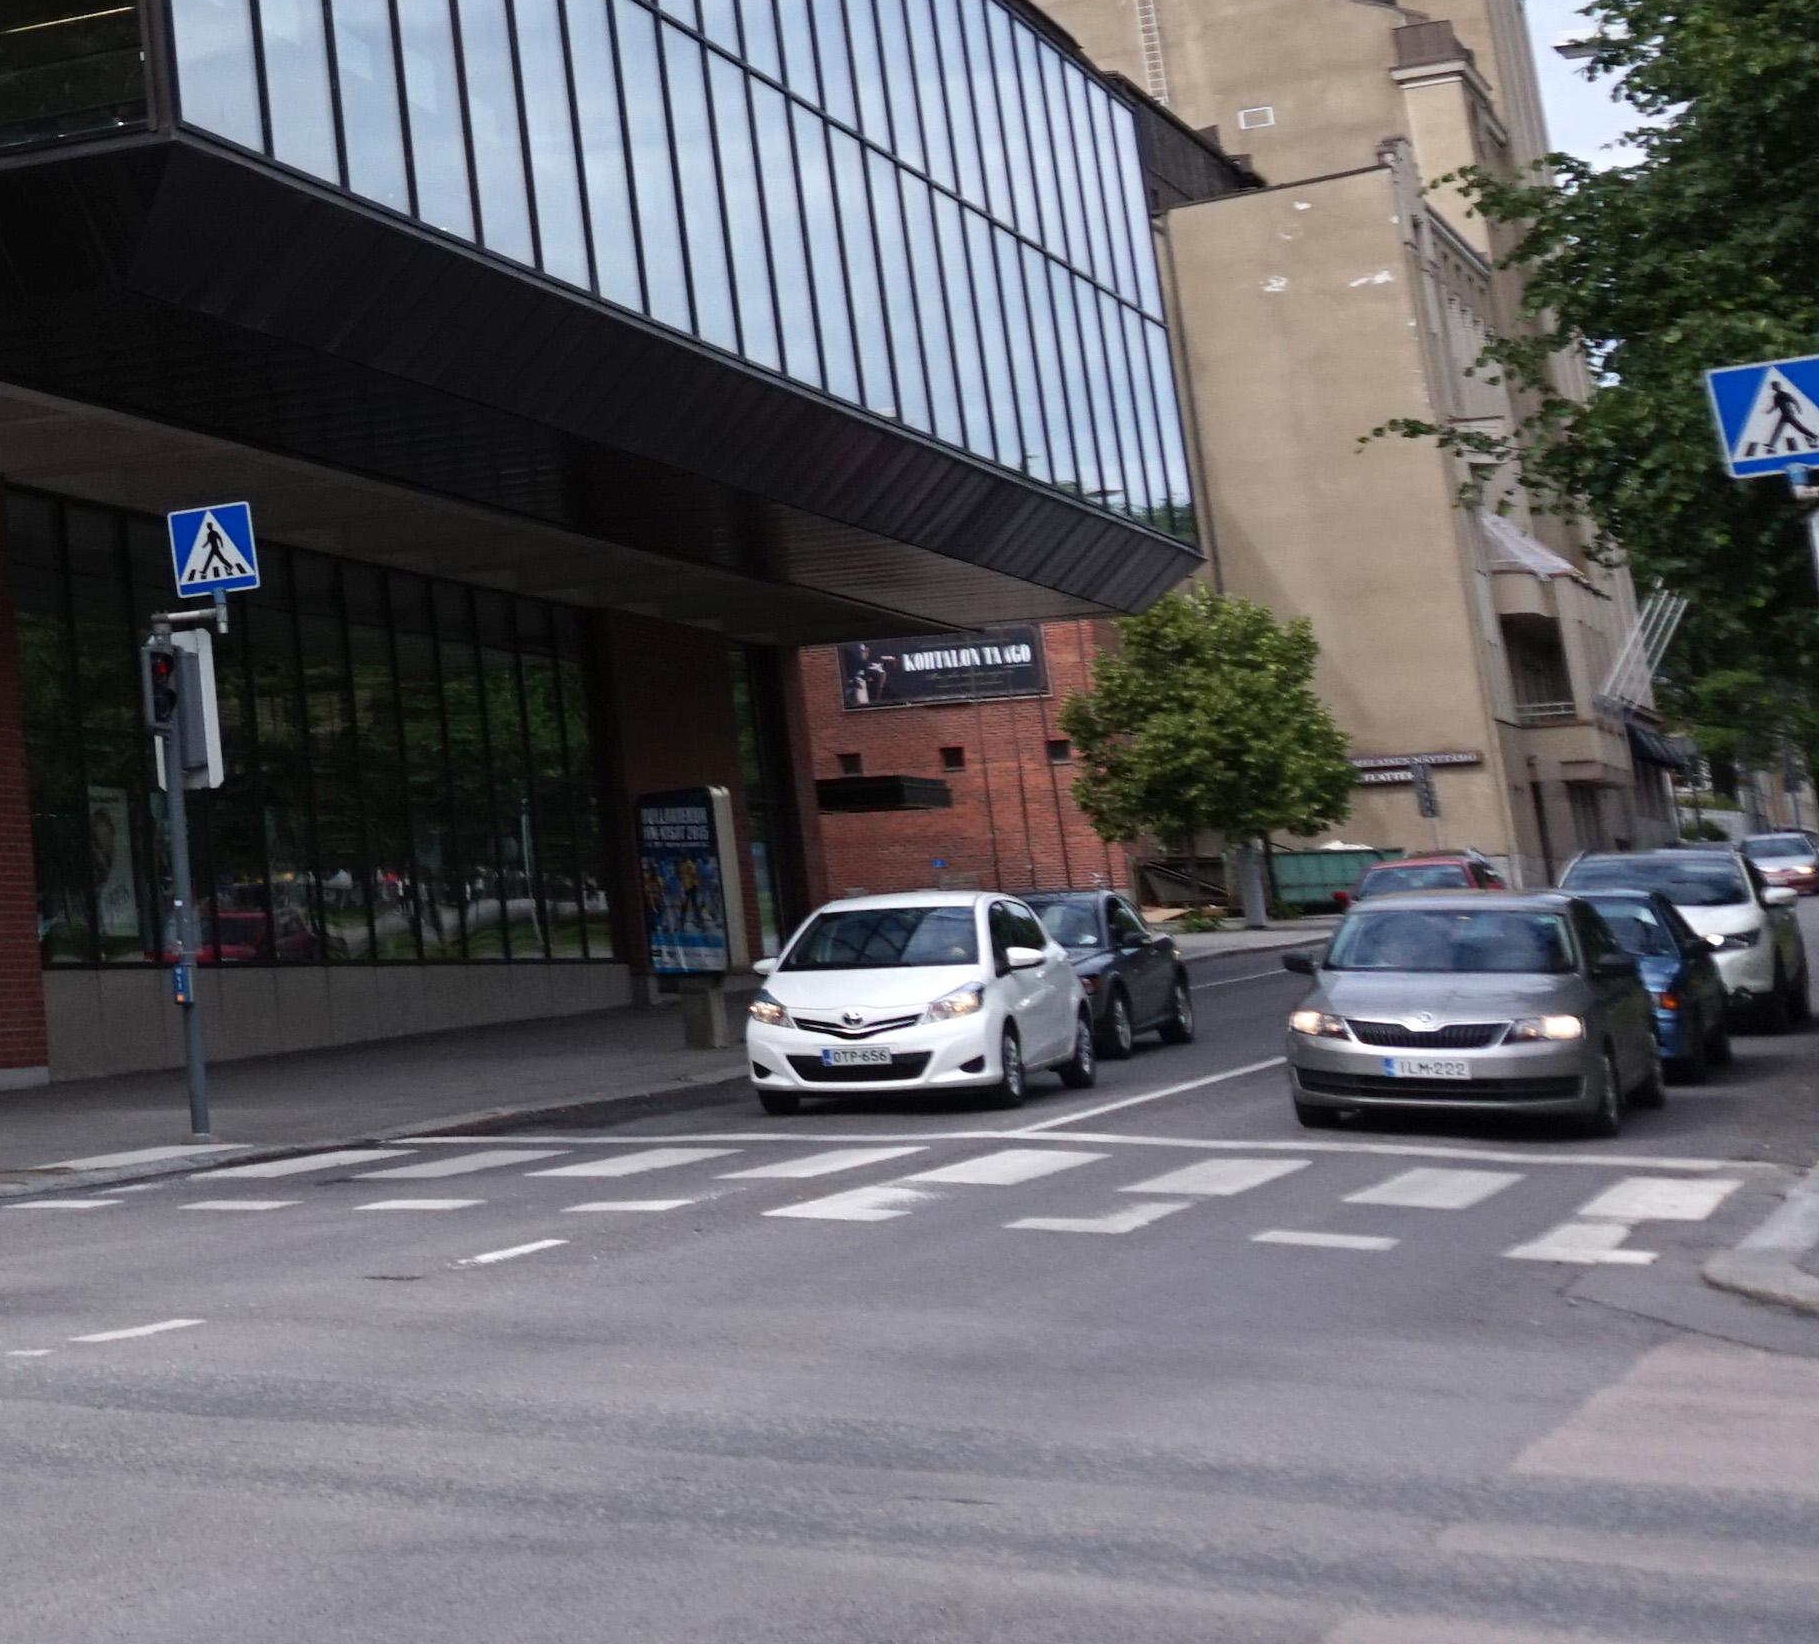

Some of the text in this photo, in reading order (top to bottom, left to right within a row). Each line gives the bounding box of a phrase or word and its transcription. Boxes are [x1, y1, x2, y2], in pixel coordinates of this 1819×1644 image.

[901, 646, 981, 672] KOHTALON
[833, 1049, 889, 1064] OTP-656
[1399, 1060, 1467, 1076] ILM-222
